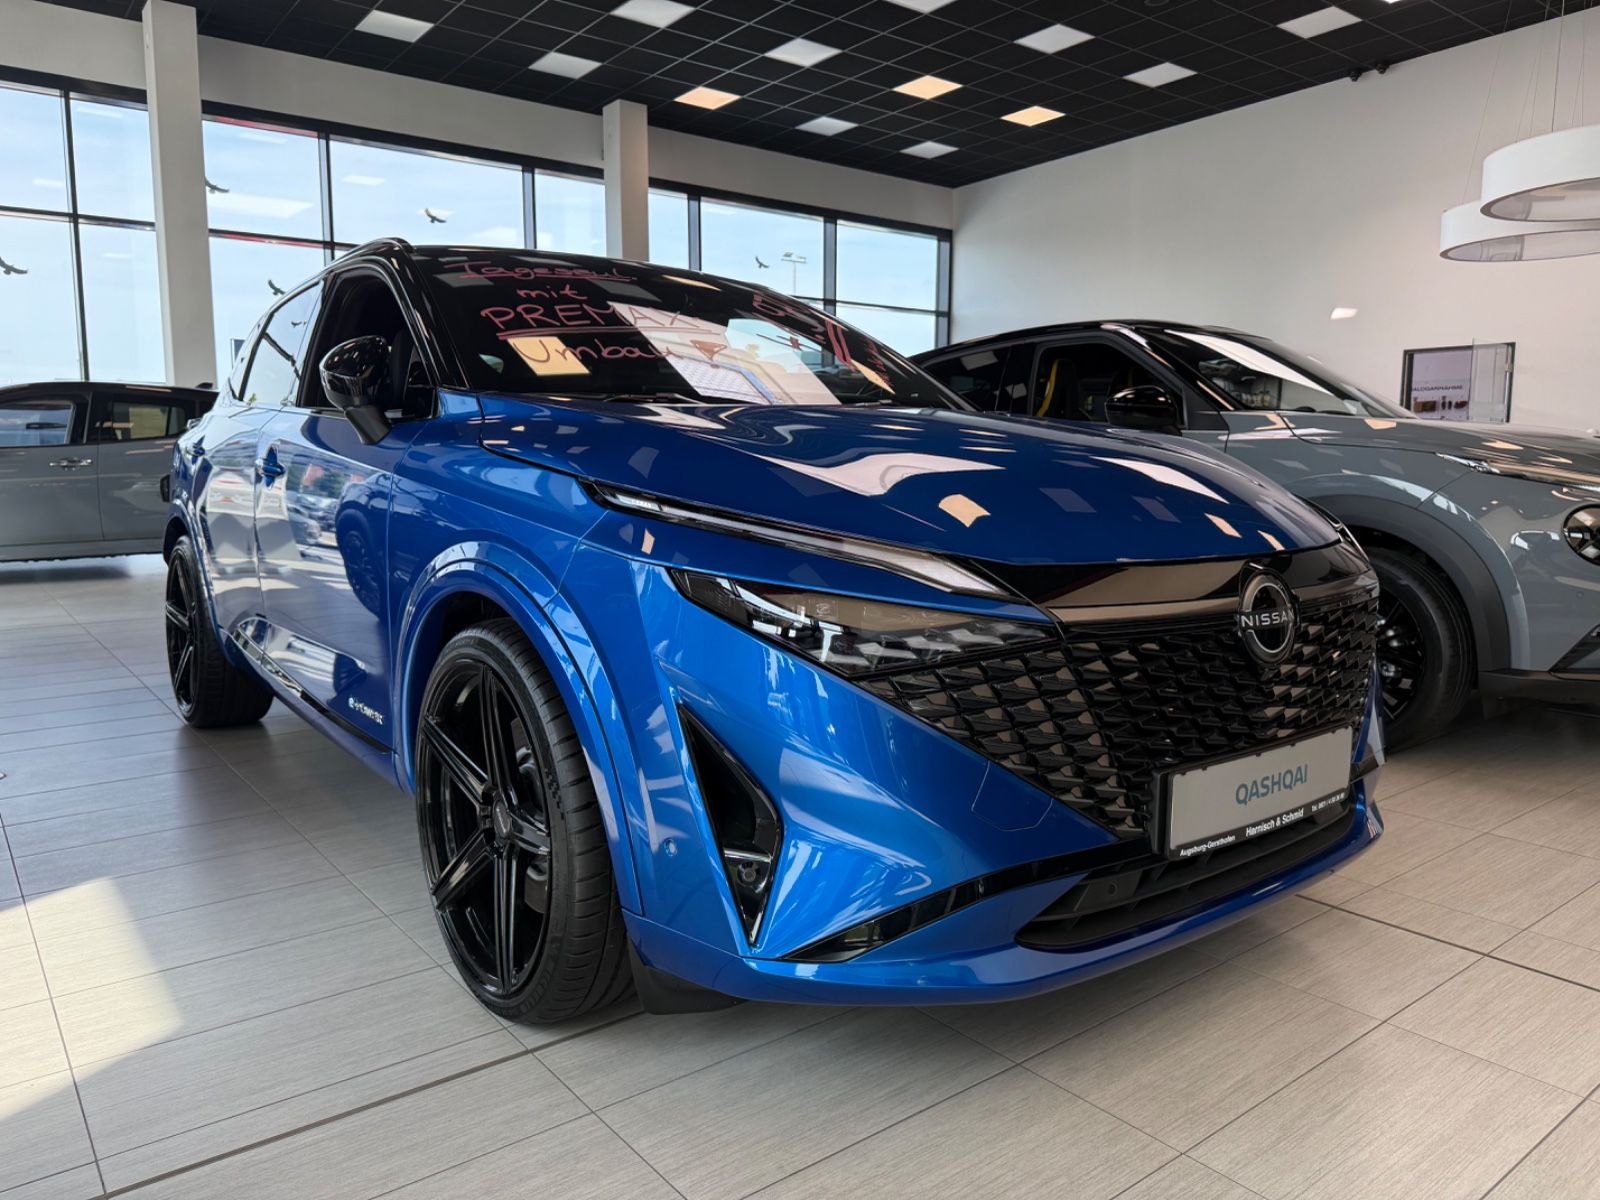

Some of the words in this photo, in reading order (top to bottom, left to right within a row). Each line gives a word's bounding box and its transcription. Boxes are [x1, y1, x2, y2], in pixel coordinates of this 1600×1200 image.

[516, 284, 588, 300] mit
[1240, 609, 1294, 628] NISSAN
[1235, 764, 1309, 807] QASHQAI
[1245, 818, 1275, 838] Harnisch
[1282, 807, 1304, 825] Schmid
